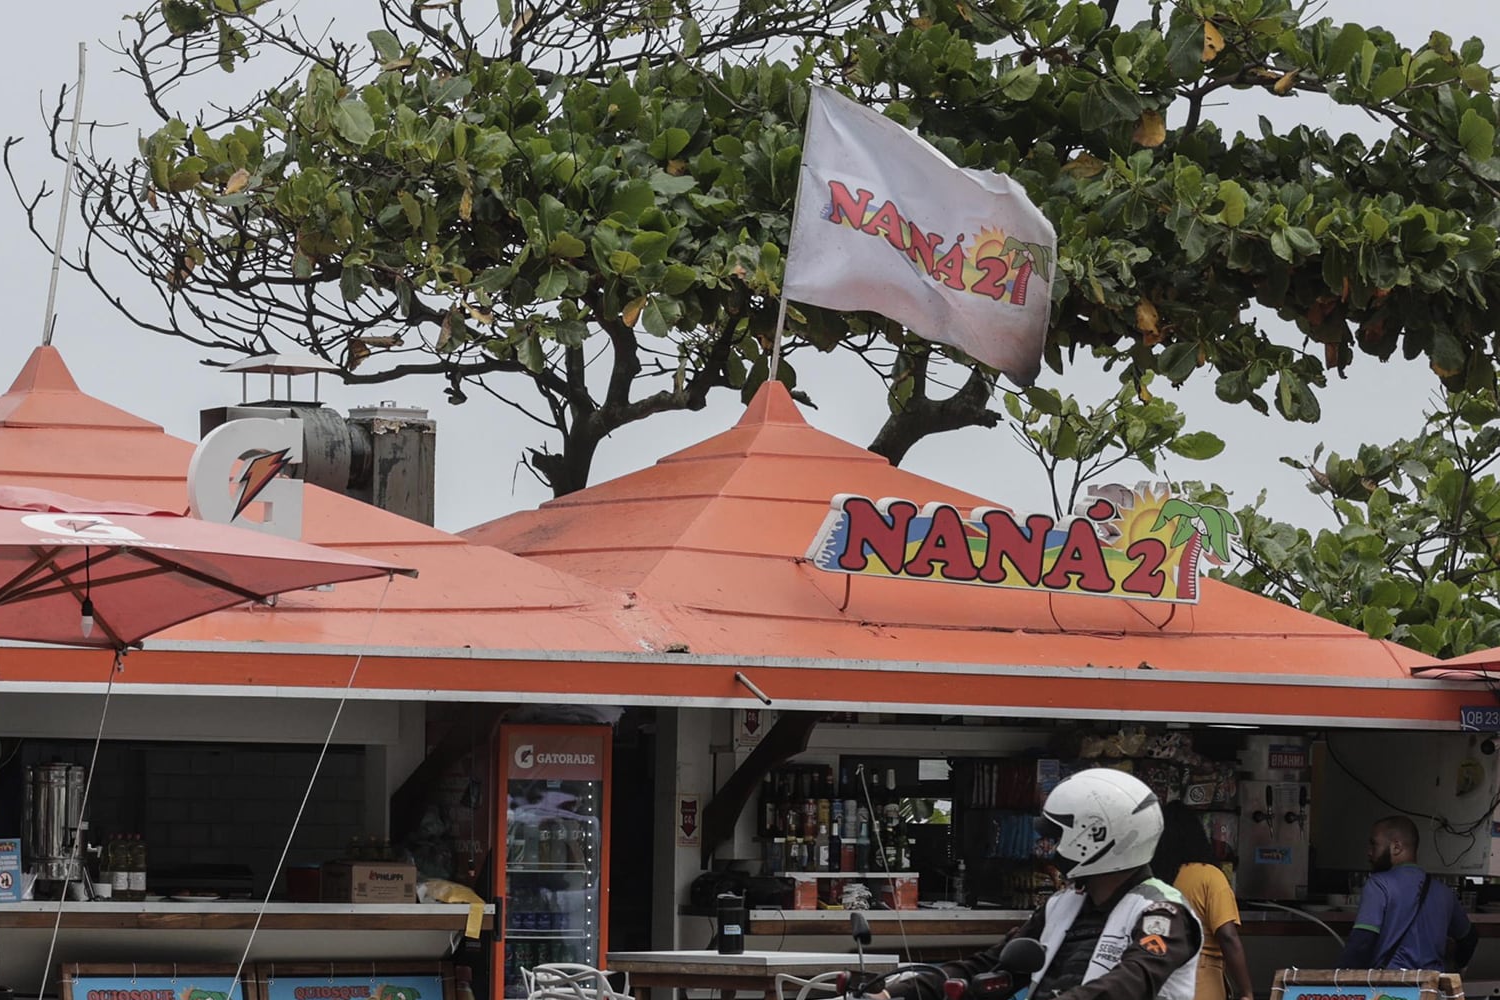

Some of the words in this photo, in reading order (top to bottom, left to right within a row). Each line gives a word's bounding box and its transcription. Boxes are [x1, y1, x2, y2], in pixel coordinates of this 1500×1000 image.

[827, 180, 966, 291] NANÁ
[839, 497, 1115, 593] NANÁ
[1466, 711, 1483, 726] QB
[1485, 711, 1500, 725] 23
[536, 753, 596, 765] GATORADE
[294, 985, 371, 1000] QUIOSQUE
